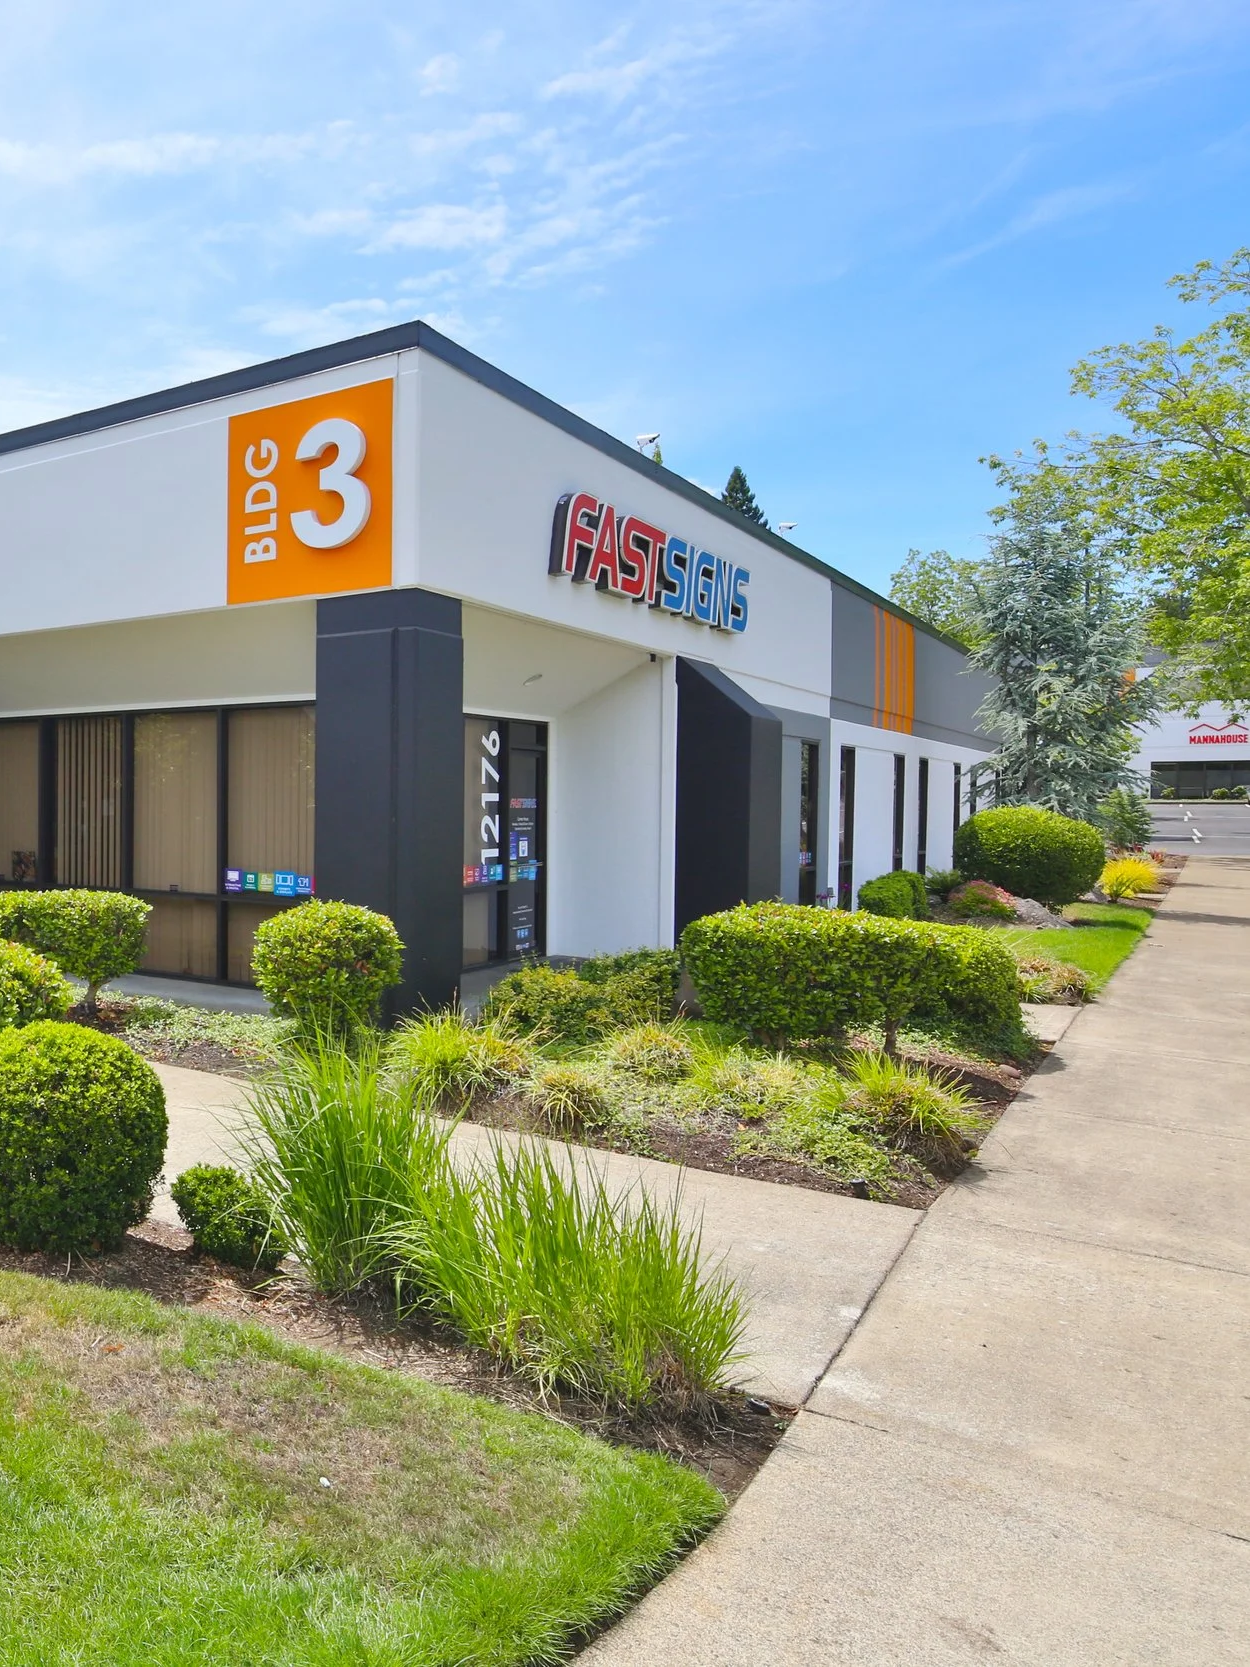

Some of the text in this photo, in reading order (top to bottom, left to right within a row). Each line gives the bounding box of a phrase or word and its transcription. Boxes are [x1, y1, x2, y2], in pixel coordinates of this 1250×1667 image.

[244, 418, 372, 564] BLDG 3
[549, 490, 751, 634] FASTSIGNS
[480, 730, 501, 866] 12176
[1189, 734, 1248, 745] MANNAHOUSE
